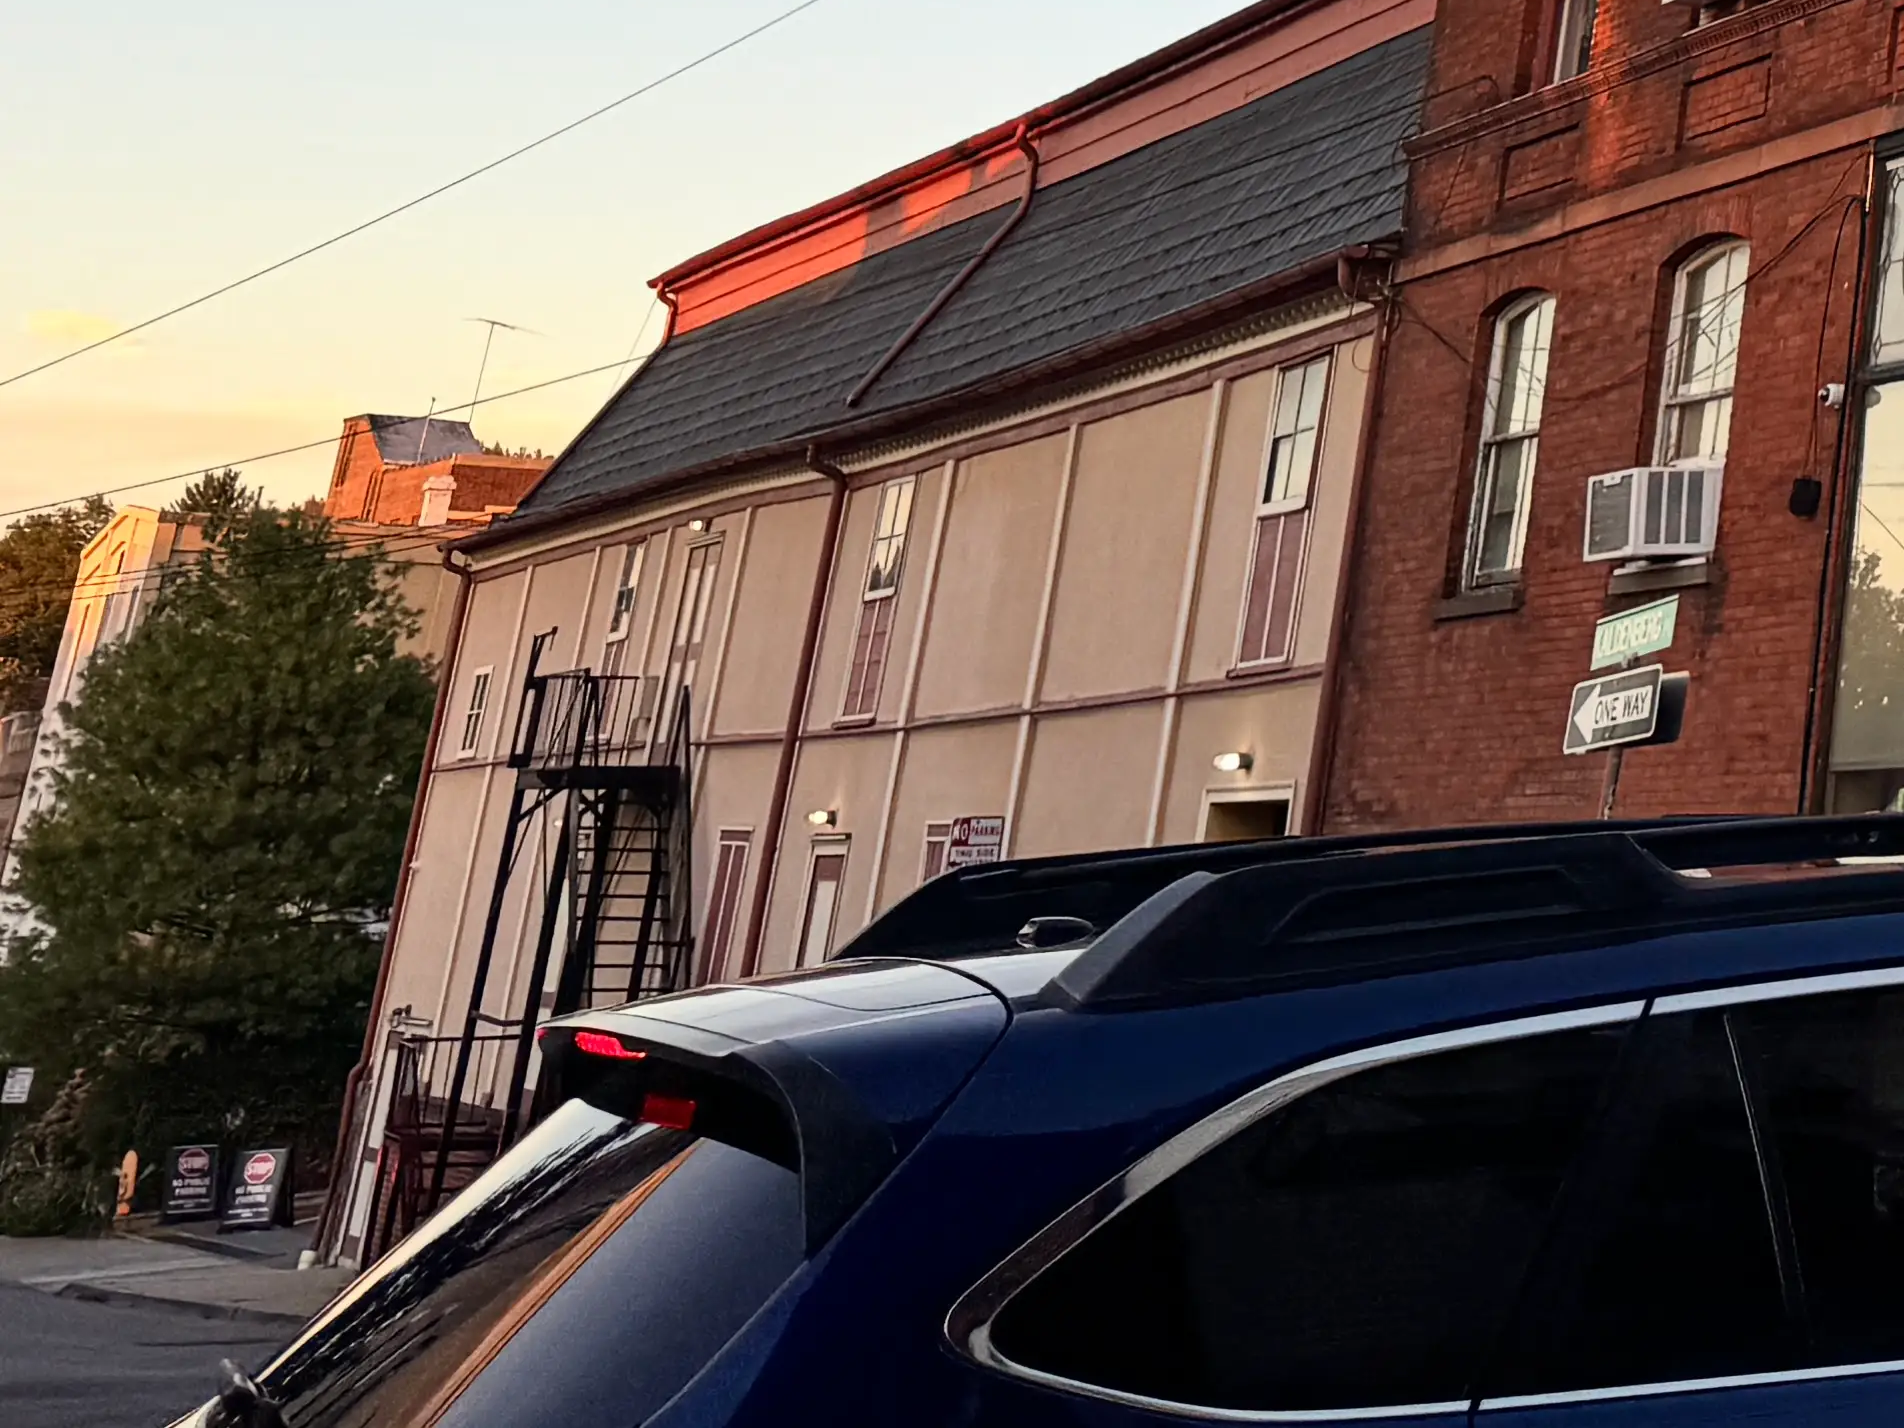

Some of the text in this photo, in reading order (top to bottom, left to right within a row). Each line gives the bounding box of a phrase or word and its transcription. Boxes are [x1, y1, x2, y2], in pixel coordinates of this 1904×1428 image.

[1594, 690, 1650, 725] ONE WAY
[952, 823, 968, 841] NO
